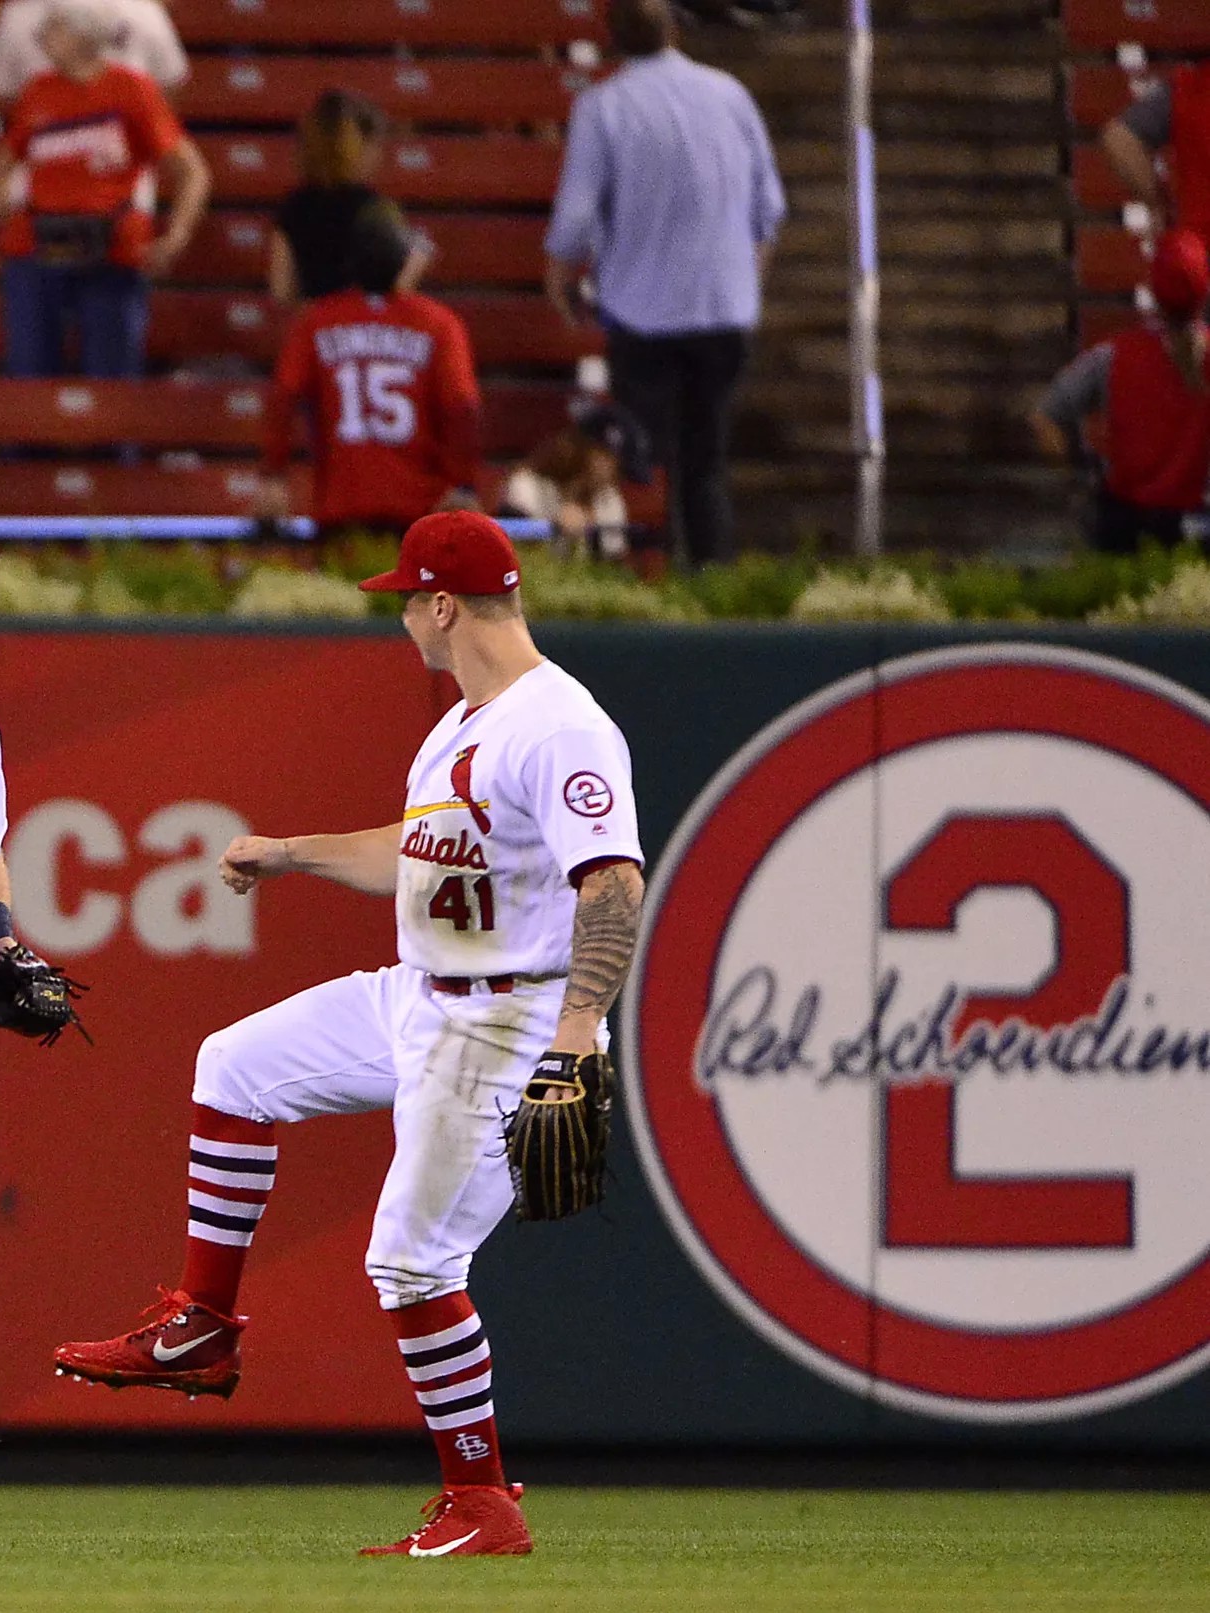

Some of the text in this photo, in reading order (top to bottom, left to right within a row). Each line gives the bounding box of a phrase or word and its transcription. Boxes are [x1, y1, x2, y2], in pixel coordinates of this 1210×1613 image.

[337, 361, 417, 444] 15
[429, 875, 495, 931] 41
[699, 966, 819, 1080] Red
[882, 809, 1134, 1249] 2
